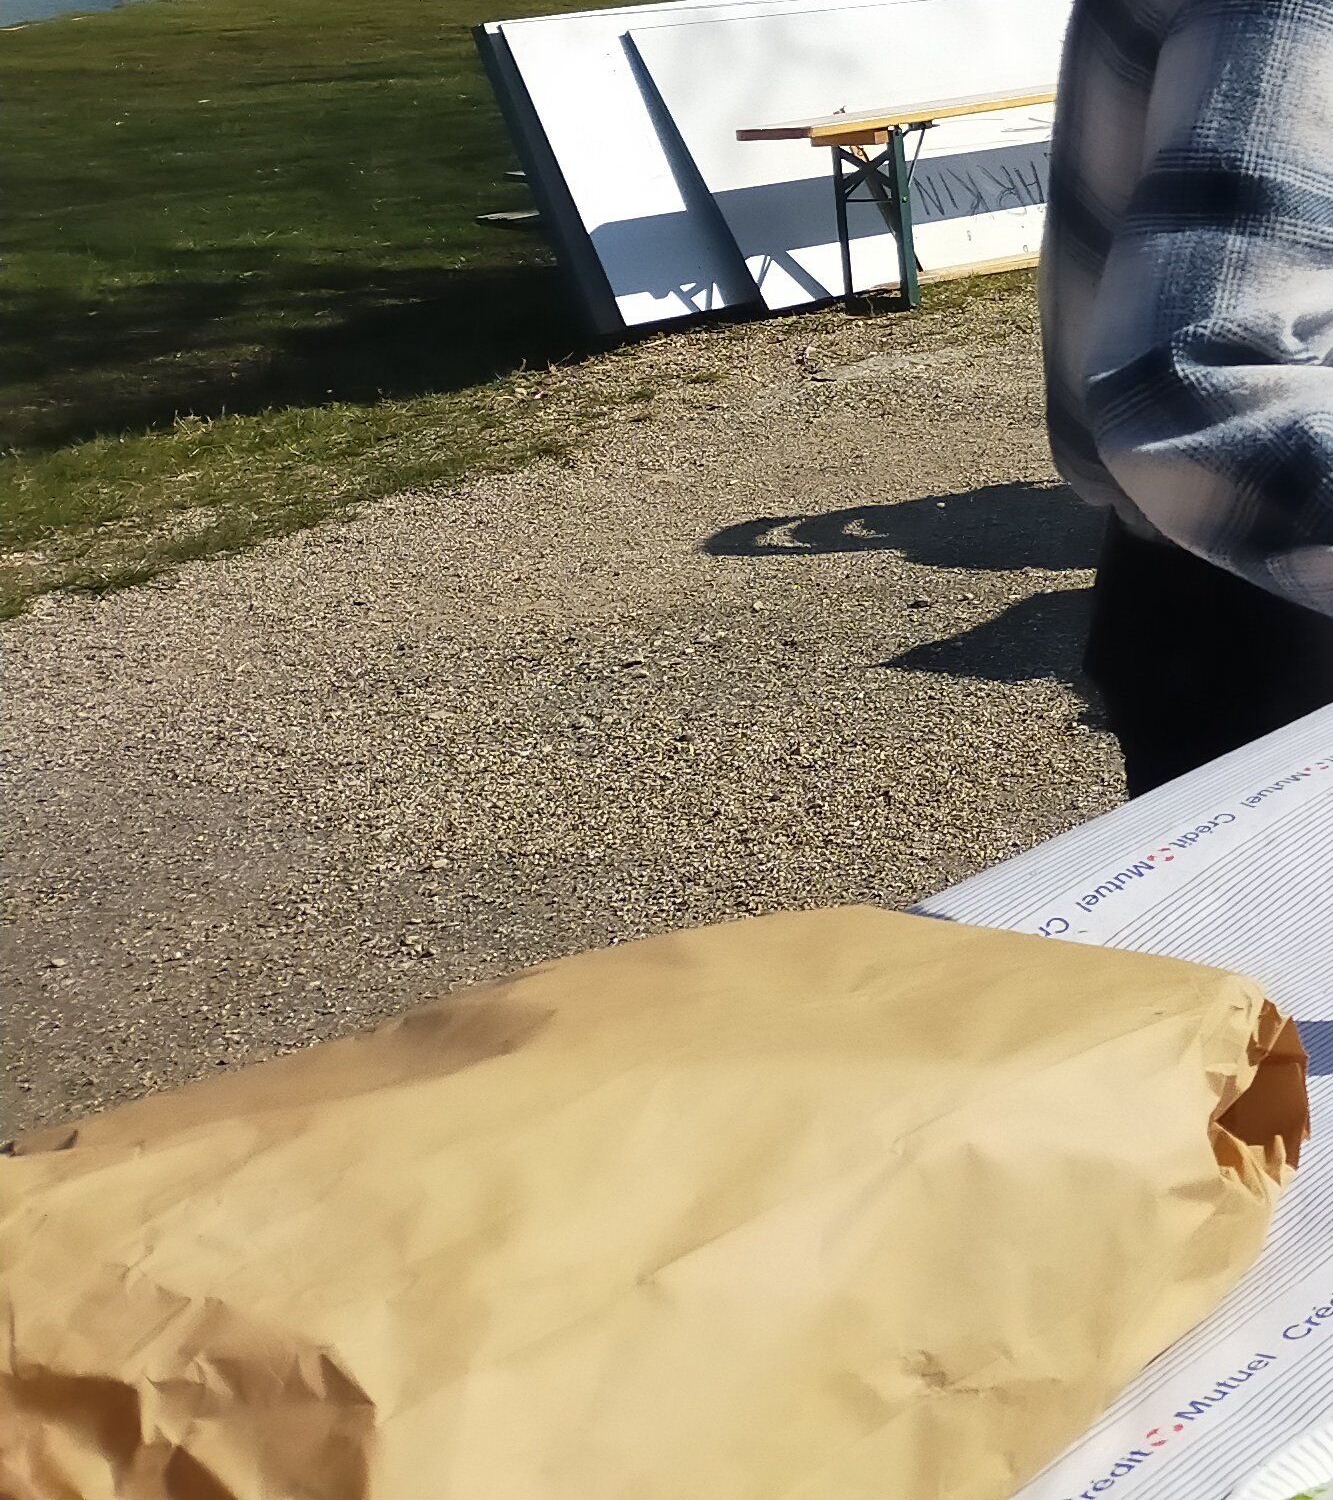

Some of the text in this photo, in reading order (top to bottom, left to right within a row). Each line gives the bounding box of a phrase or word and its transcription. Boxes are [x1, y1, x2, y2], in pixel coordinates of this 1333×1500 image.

[911, 160, 1048, 221] ARKIN
[1240, 768, 1314, 809] Mutuel
[1170, 811, 1237, 850] Crédit
[1075, 859, 1156, 913] Mutuel
[1063, 1448, 1154, 1500] rédit
[1173, 1353, 1278, 1421] Mutuel
